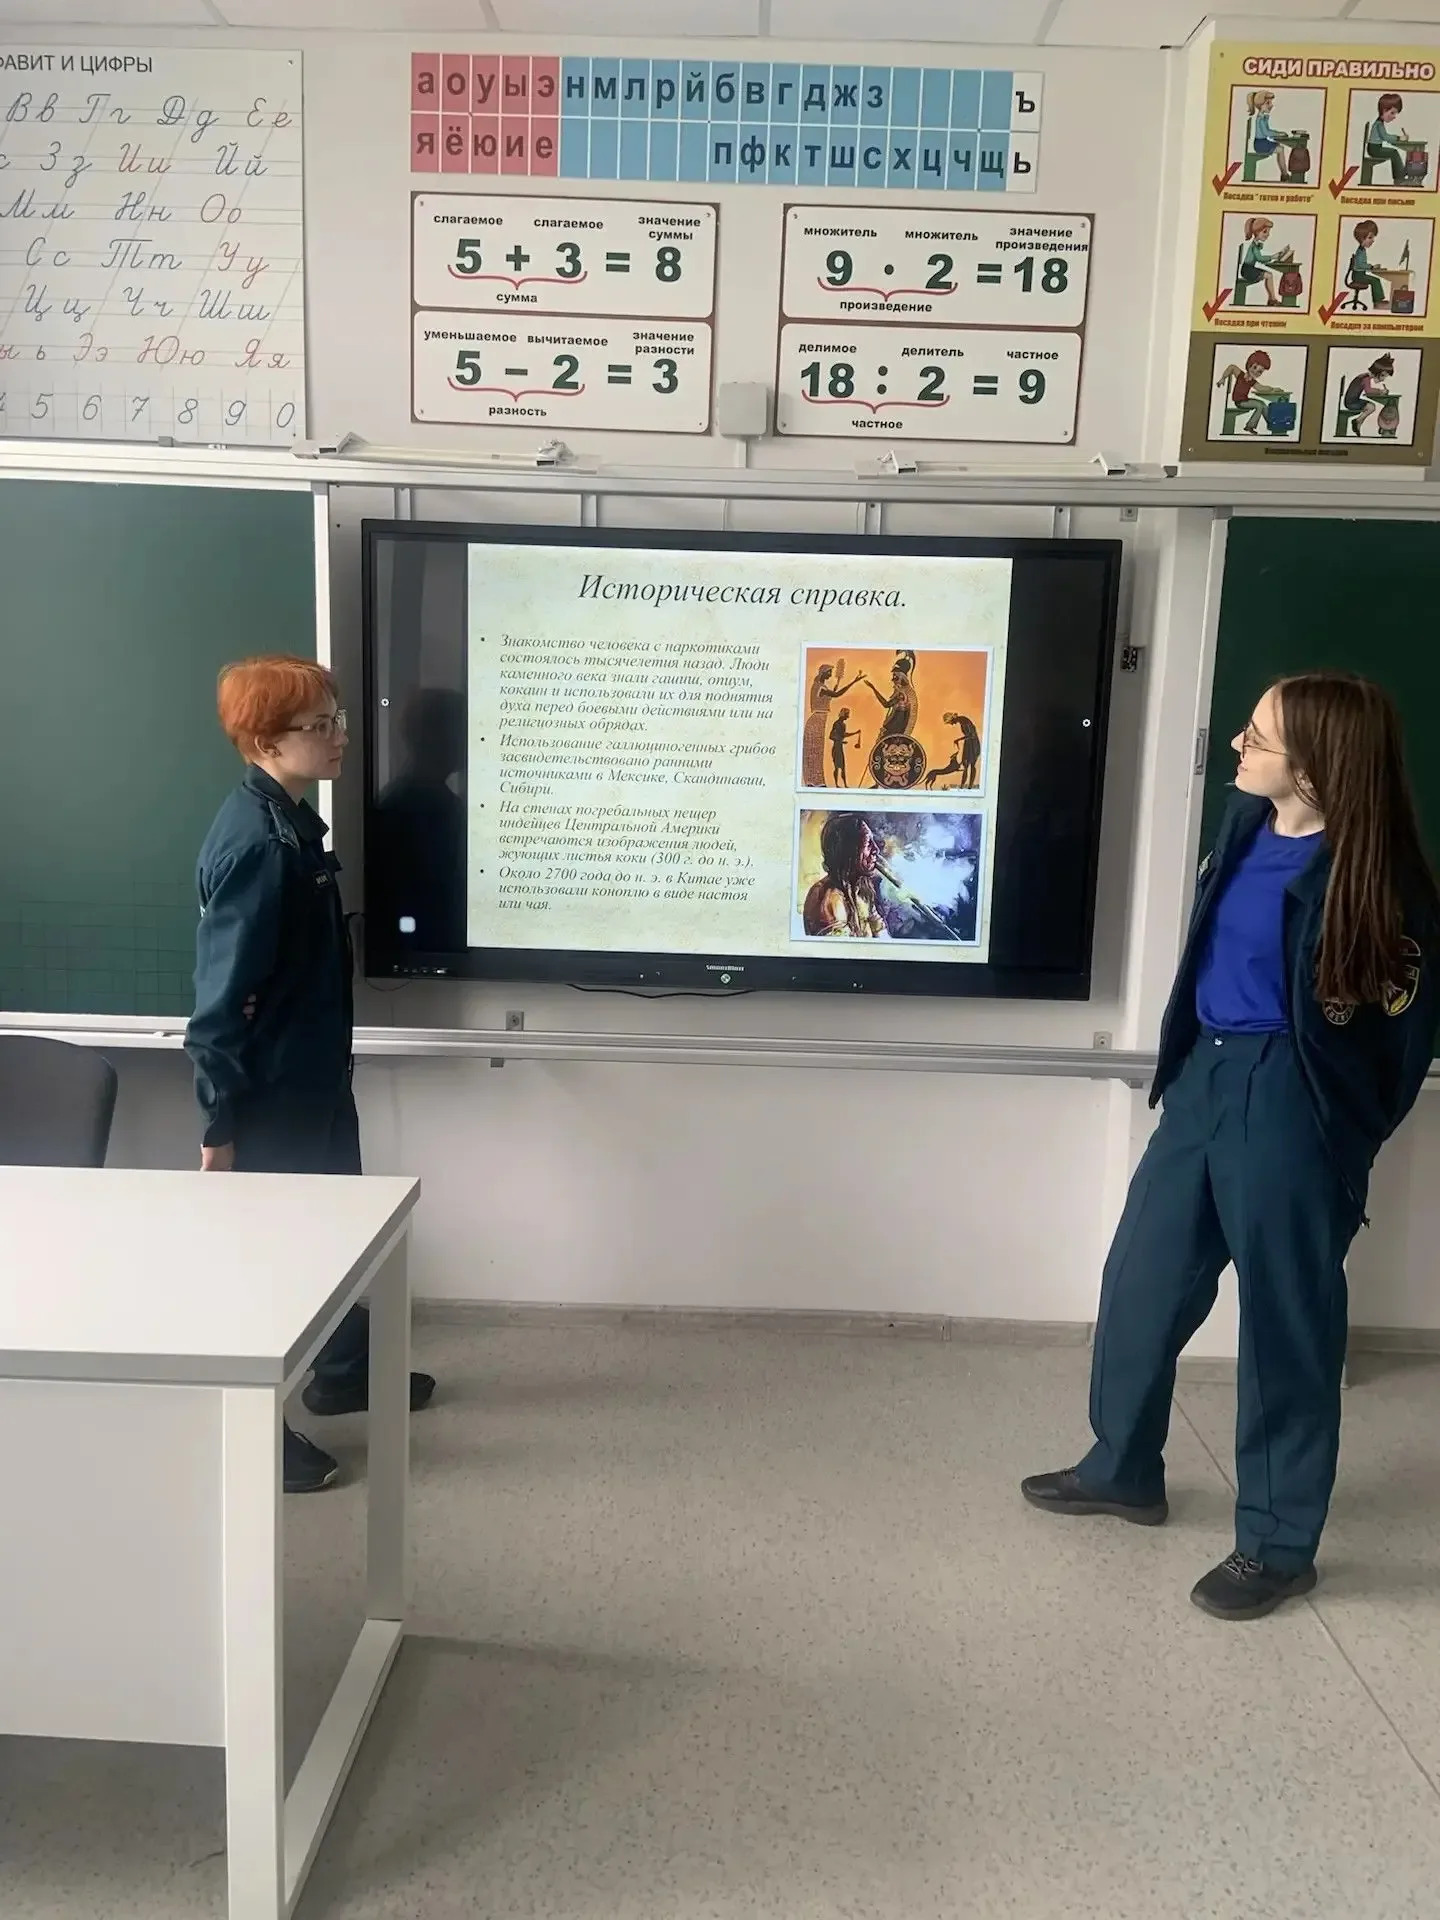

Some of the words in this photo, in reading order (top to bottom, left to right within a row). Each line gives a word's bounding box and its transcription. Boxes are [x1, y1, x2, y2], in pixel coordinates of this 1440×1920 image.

[61, 56, 74, 73] И
[81, 56, 153, 75] ЦИФРЫ
[1243, 57, 1301, 78] СИДИ
[1306, 59, 1436, 81] ПРАВИЛЬНО
[433, 214, 503, 226] слагаемое
[533, 217, 604, 230] слагаемое
[638, 215, 701, 228] значение
[648, 230, 694, 241] суммы
[803, 226, 878, 238] множитель
[905, 229, 979, 242] множитель
[1009, 227, 1073, 239] значение
[995, 240, 1089, 252] произведения
[455, 238, 482, 274] 5
[555, 242, 582, 278] 3
[655, 246, 682, 283] 8
[825, 250, 853, 286] 9
[925, 253, 954, 290] 2
[1013, 256, 1070, 294] 18
[496, 291, 538, 304] сумма
[839, 301, 933, 313] произведение
[424, 329, 517, 343] уменьшаемое
[527, 333, 609, 347] вычитаемое
[632, 331, 695, 343] значение
[634, 344, 695, 356] разности
[798, 343, 858, 355] делимое
[901, 346, 965, 358] делитель
[1006, 350, 1059, 361] частное
[455, 350, 482, 386] 5
[552, 354, 580, 390] 2
[651, 358, 679, 395] 3
[800, 361, 855, 399] 18
[917, 365, 946, 401] 2
[1018, 369, 1047, 405] 9
[31, 393, 54, 420] 5
[82, 394, 102, 421] 6
[132, 396, 150, 422] 7
[178, 397, 199, 424] 8
[225, 399, 247, 426] 9
[276, 402, 295, 428] 0
[488, 405, 548, 418] разность
[851, 419, 903, 430] частное
[578, 574, 781, 608] Историческая
[790, 584, 908, 612] справка.
[501, 634, 585, 649] Знакомство
[590, 640, 650, 652] человека
[653, 643, 661, 652] с
[665, 643, 760, 655] наркотиками
[500, 653, 580, 665] состоялось
[584, 657, 679, 668] тысячелетия
[683, 657, 725, 670] назад.
[729, 657, 770, 671] Люди
[500, 670, 572, 680] каменного
[576, 672, 607, 682] века
[611, 673, 649, 683] знали
[652, 675, 703, 686] гашиш,
[708, 676, 753, 689] опиум,
[500, 686, 547, 696] кокаин
[552, 688, 560, 697] и
[564, 688, 655, 700] использовали
[660, 691, 674, 700] их
[678, 688, 701, 701] для
[705, 691, 773, 703] поднятия
[500, 699, 531, 714] духа
[535, 702, 574, 715] перед
[578, 701, 638, 715] боевыми
[641, 704, 726, 718] действиями
[729, 708, 753, 719] или
[756, 709, 774, 719] на
[499, 717, 586, 730] религиозных
[589, 718, 648, 733] обрядах.
[500, 734, 602, 750] Использование
[606, 740, 727, 754] галлюциногенных
[729, 742, 777, 757] грибов
[500, 751, 650, 767] засвидетельствовано
[653, 758, 713, 770] ранними
[499, 768, 592, 781] источниками
[596, 772, 603, 781] в
[608, 769, 668, 784] Мексике,
[673, 771, 766, 787] Скандинавии,
[500, 780, 554, 797] Сибири.
[499, 800, 520, 813] На
[523, 805, 572, 815] стенах
[576, 804, 670, 819] погребальных
[673, 809, 717, 822] пещер
[499, 817, 561, 831] индейцев
[565, 818, 657, 834] Центральной
[661, 821, 720, 837] Америки
[499, 834, 593, 847] встречаются
[597, 836, 689, 851] изображения
[692, 839, 737, 852] людей,
[498, 850, 561, 863] жующих
[562, 851, 612, 862] листья
[616, 853, 647, 863] коки
[651, 852, 680, 866] (300
[698, 853, 714, 866] до
[499, 866, 541, 879] Около
[545, 867, 578, 880] 2700
[580, 869, 611, 881] года
[614, 870, 631, 882] до
[665, 875, 673, 884] в
[677, 871, 722, 886] Китае
[724, 875, 756, 888] уже
[499, 884, 588, 896] использовали
[591, 887, 650, 899] коноплю
[653, 890, 661, 899] в
[664, 888, 695, 900] виде
[698, 891, 748, 901] настоя
[498, 899, 522, 909] или
[525, 901, 552, 910] чая.
